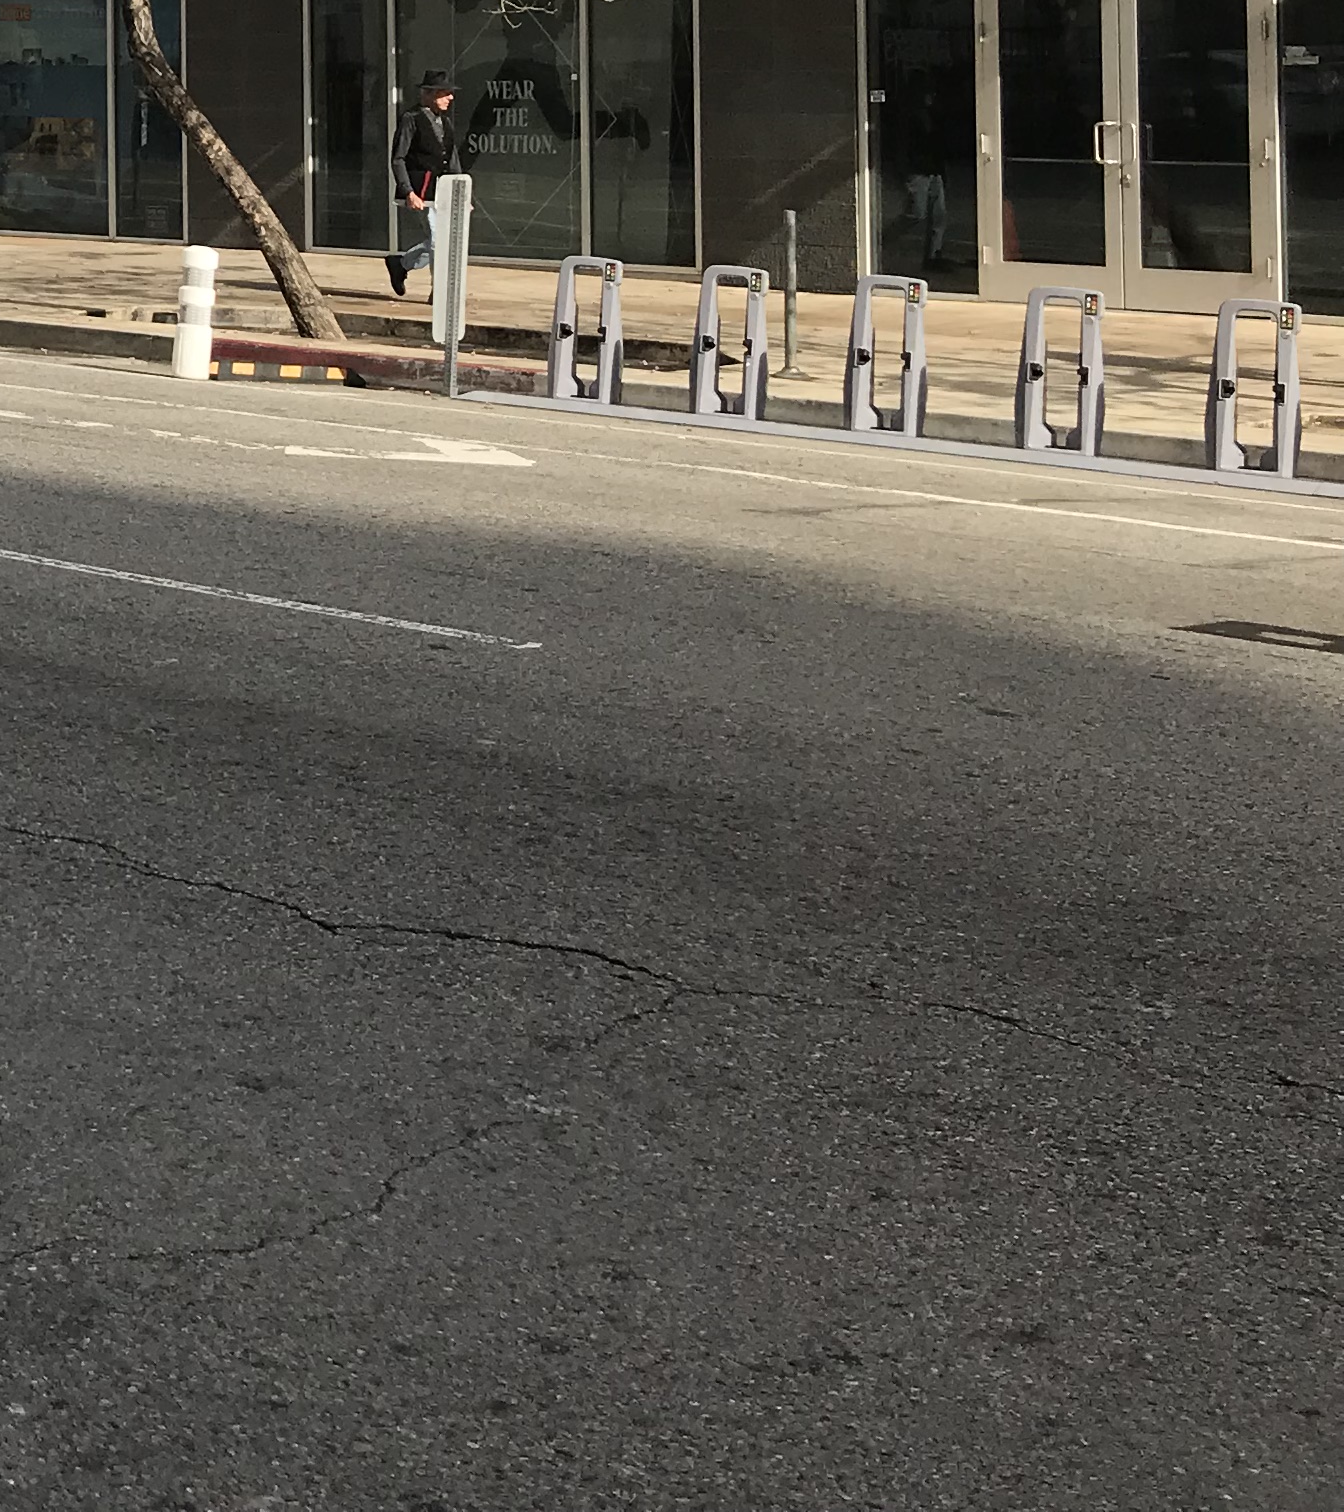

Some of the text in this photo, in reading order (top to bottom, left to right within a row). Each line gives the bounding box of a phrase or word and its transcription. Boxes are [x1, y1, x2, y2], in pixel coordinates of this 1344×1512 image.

[485, 79, 537, 101] WEAR
[493, 107, 529, 127] THE
[468, 133, 557, 155] SOLUTION.
